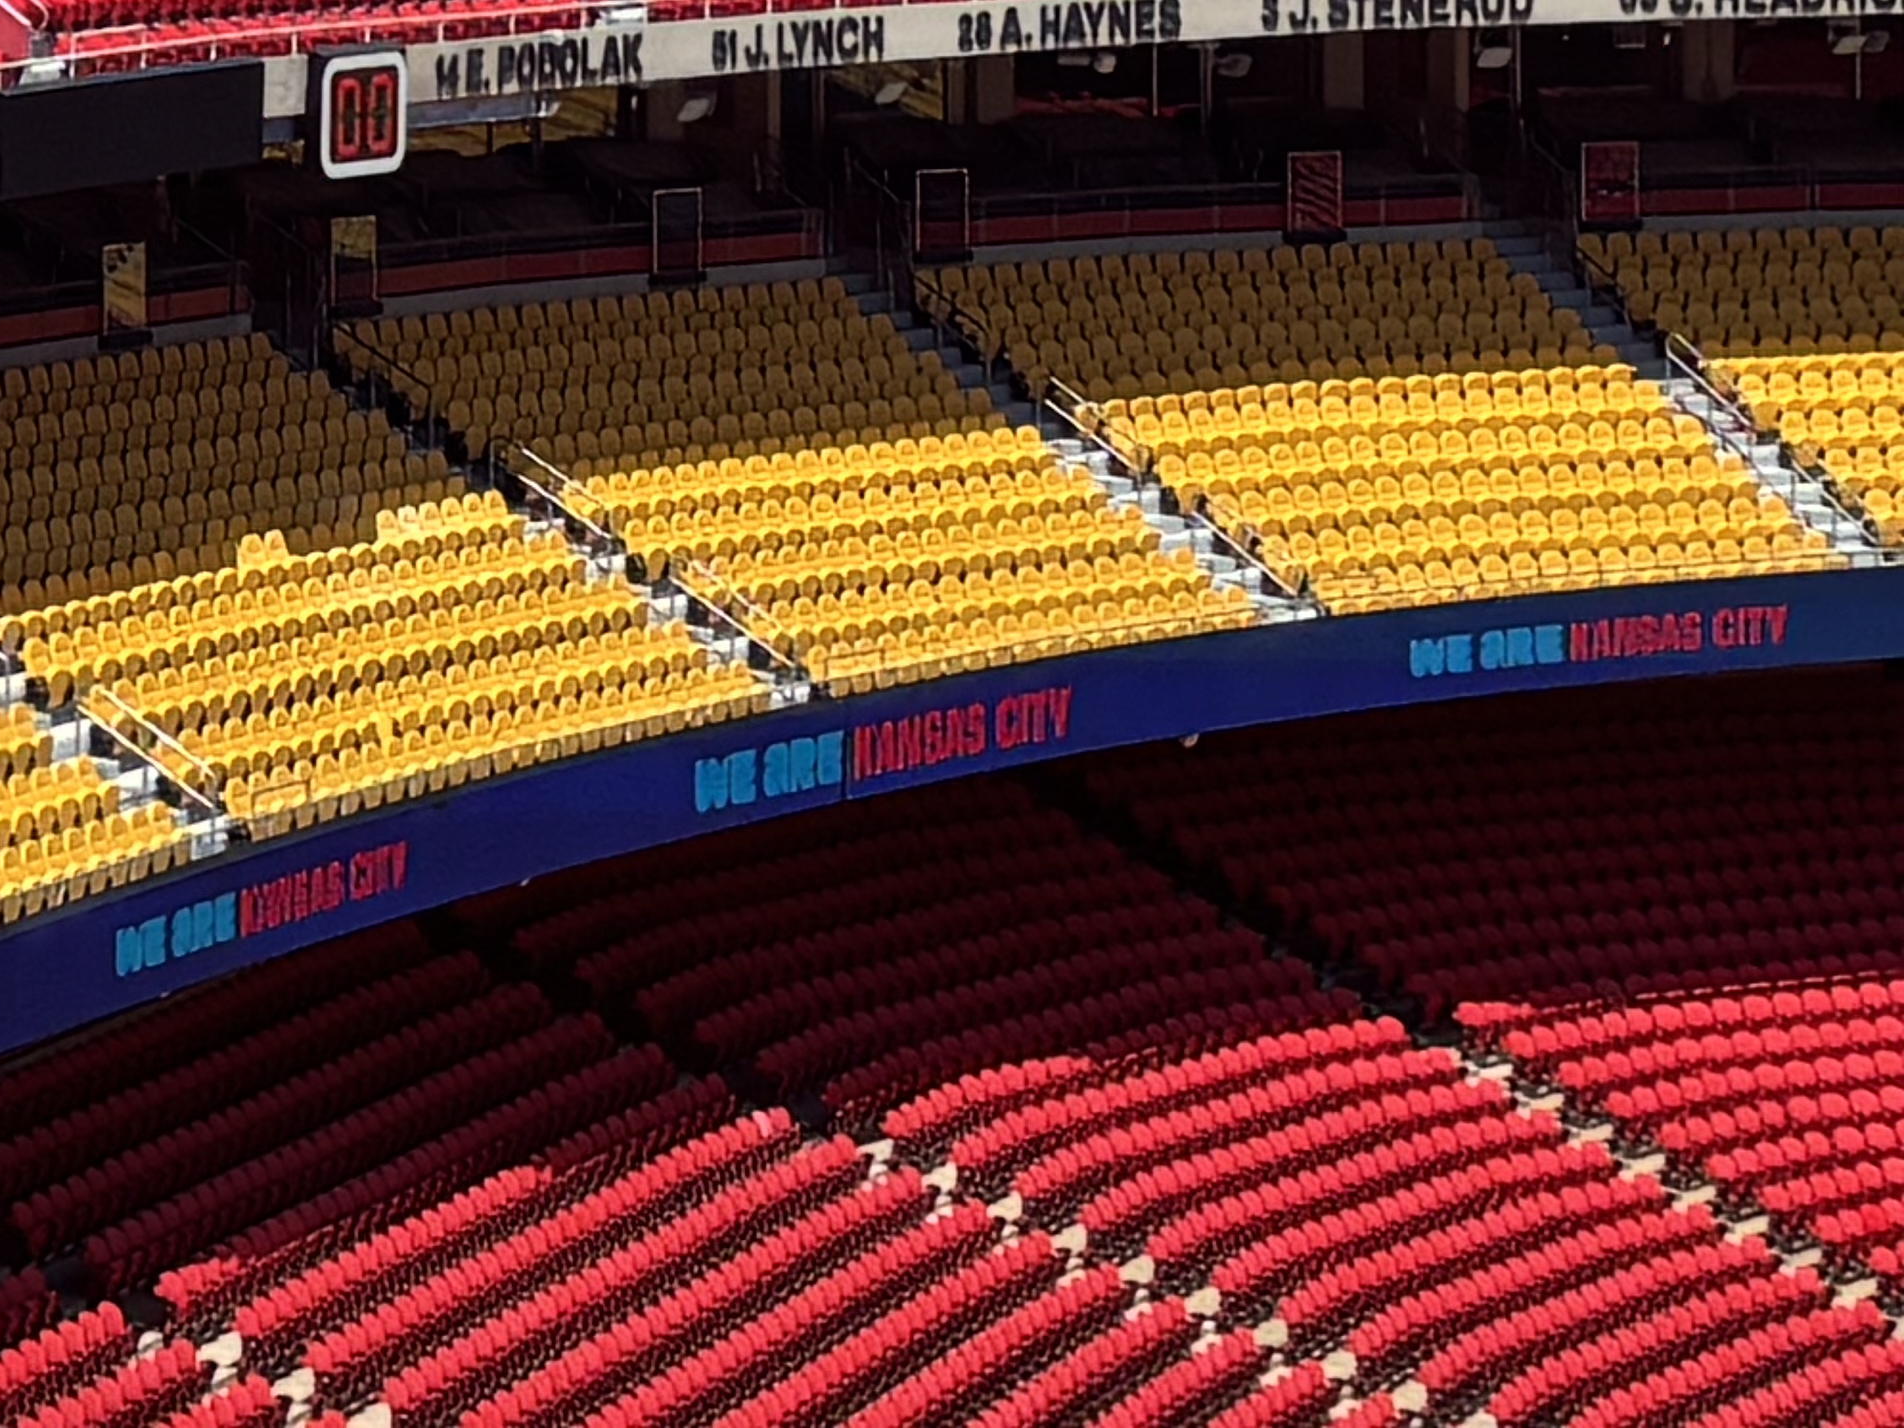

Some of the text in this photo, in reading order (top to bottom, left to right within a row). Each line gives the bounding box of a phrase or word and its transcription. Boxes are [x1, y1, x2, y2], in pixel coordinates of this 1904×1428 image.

[744, 23, 769, 68] J.
[777, 15, 884, 68] LYNCH
[1000, 6, 1032, 51] A.
[497, 32, 643, 92] PODOLAK
[1569, 611, 1703, 664] KANSAS
[1711, 604, 1789, 650] CITY
[853, 702, 987, 781] KANSAS
[995, 685, 1073, 751] CITY
[240, 860, 345, 939] KANSAS
[349, 841, 408, 902] CITY
